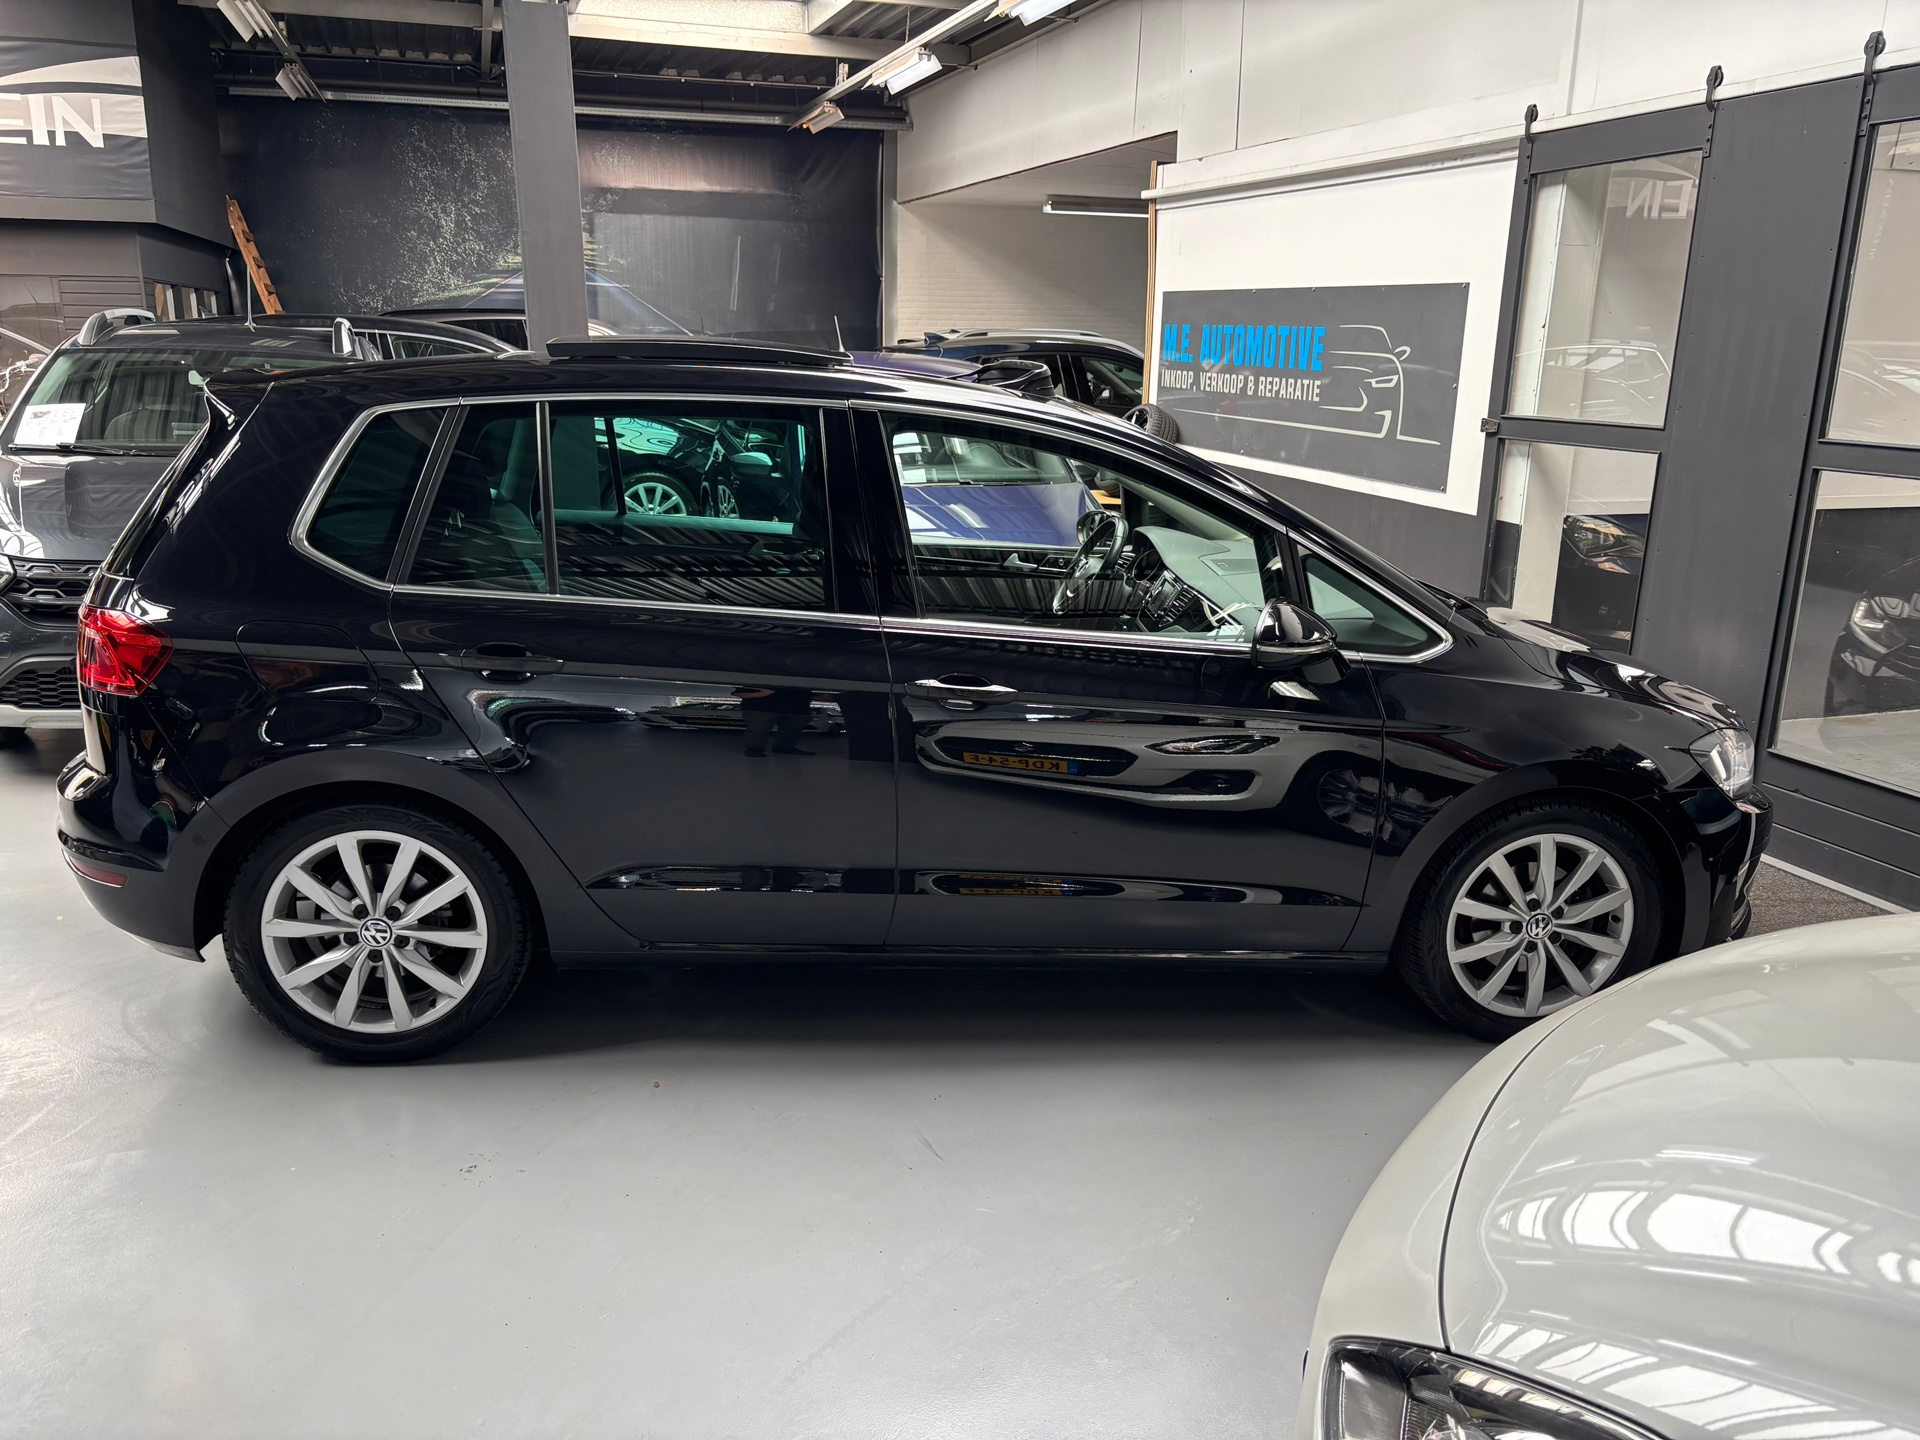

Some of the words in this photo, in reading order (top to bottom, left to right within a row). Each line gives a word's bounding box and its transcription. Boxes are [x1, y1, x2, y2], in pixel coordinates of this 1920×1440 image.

[1162, 324, 1194, 363] M.E.
[1199, 324, 1326, 372] AUTOMOTIVE
[1161, 369, 1197, 393] INKOOP,
[1200, 371, 1244, 395] VERKOOP
[1247, 375, 1255, 396] &
[1258, 376, 1322, 402] REPARATIE
